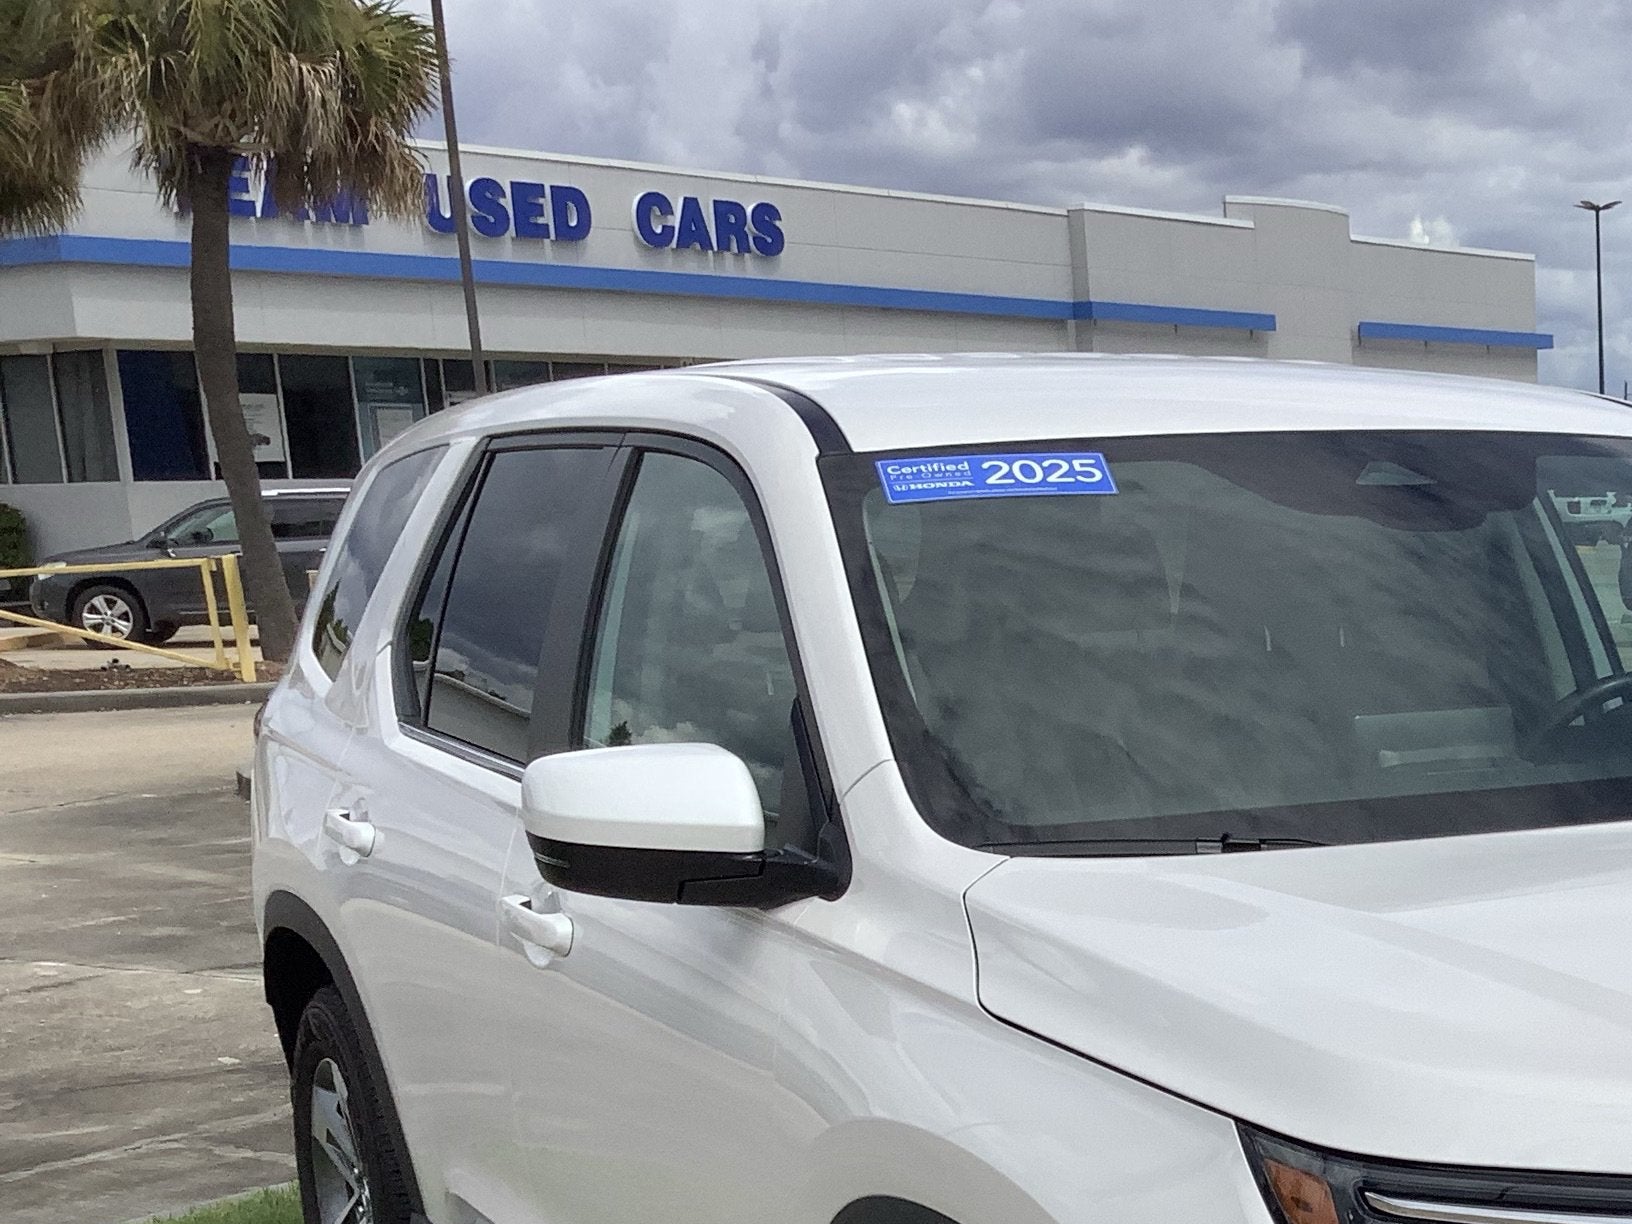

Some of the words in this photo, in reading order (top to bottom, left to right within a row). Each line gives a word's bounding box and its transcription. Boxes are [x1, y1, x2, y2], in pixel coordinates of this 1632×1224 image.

[424, 172, 592, 242] USED
[632, 190, 785, 258] CARS
[886, 460, 971, 476] Certified
[980, 458, 1104, 485] 2025
[908, 480, 975, 490] HONDA
